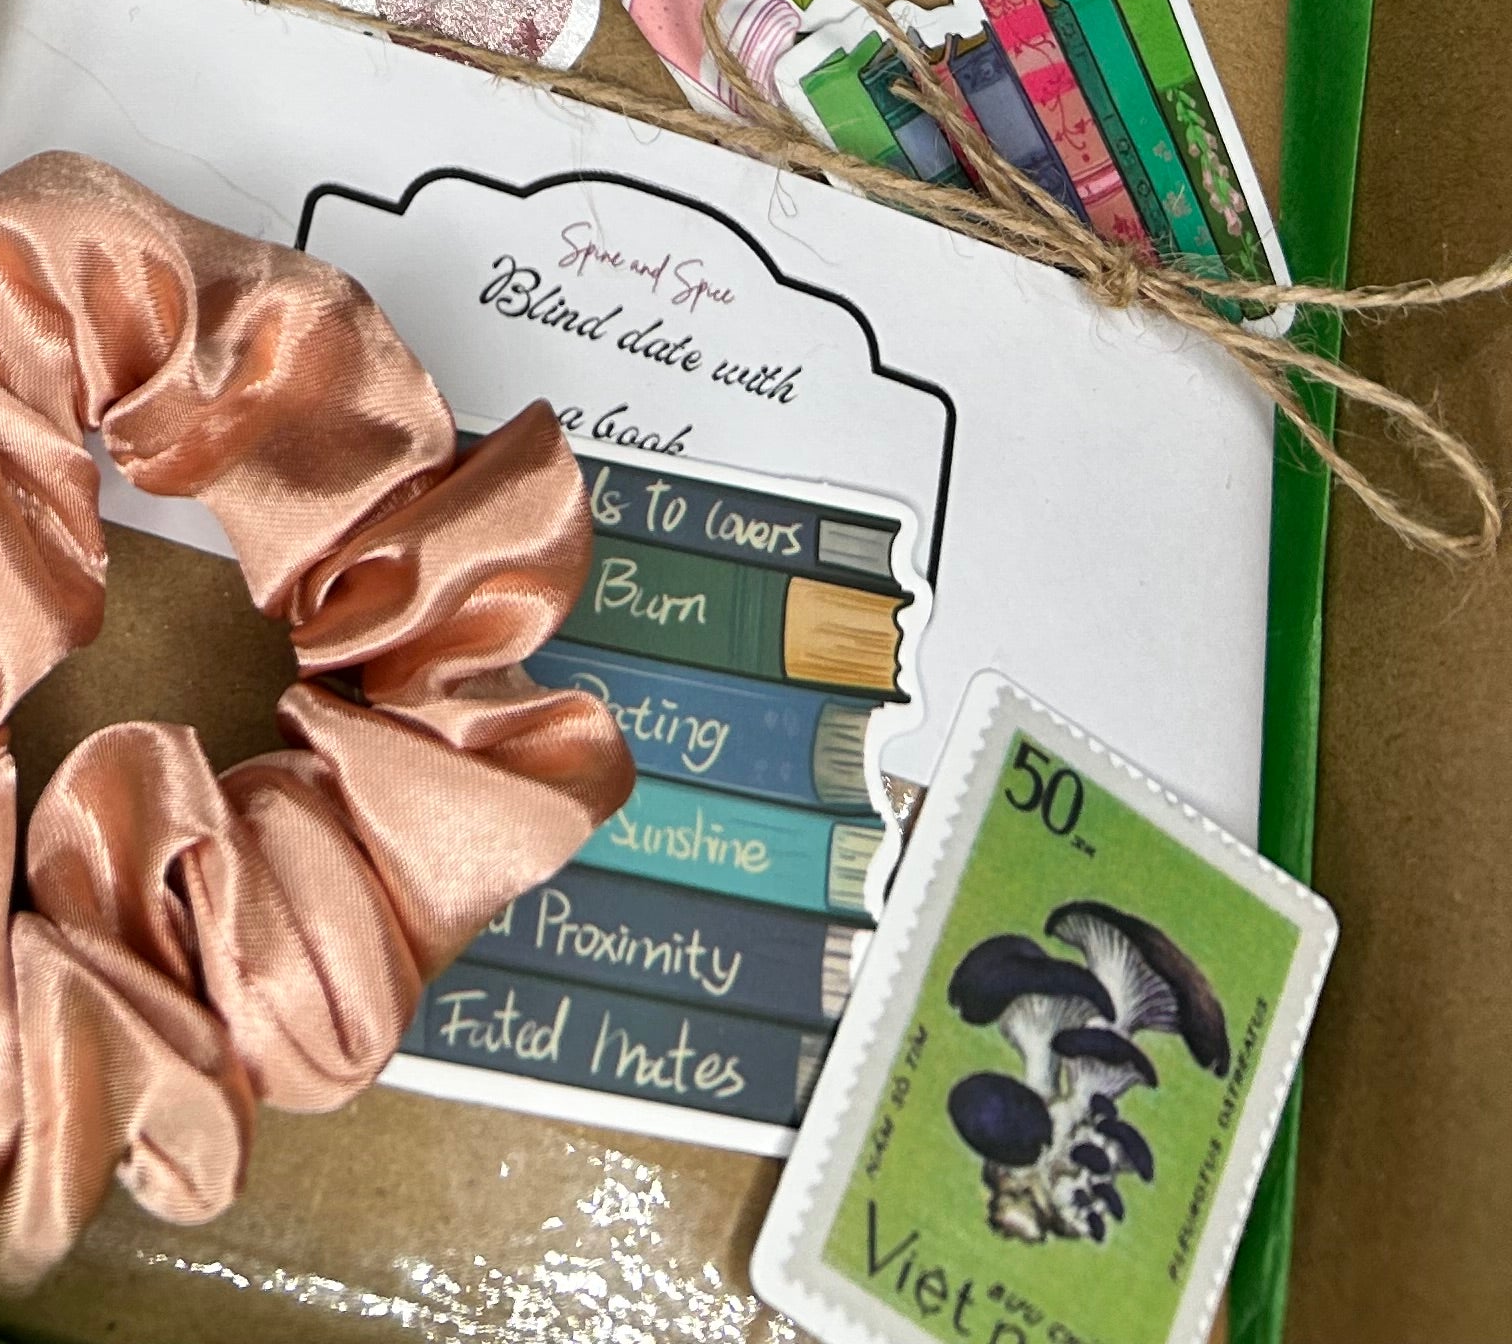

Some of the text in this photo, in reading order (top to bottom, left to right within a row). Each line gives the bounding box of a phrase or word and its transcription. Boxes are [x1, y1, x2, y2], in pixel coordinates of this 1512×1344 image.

[629, 253, 672, 294] and
[477, 253, 805, 406] Blind date with
[555, 405, 586, 432] a
[644, 478, 688, 534] to
[704, 499, 806, 558] lovers
[594, 556, 708, 627] Burn
[1004, 740, 1085, 837] 50
[534, 887, 743, 997] Proximity
[435, 988, 573, 1065] Fated
